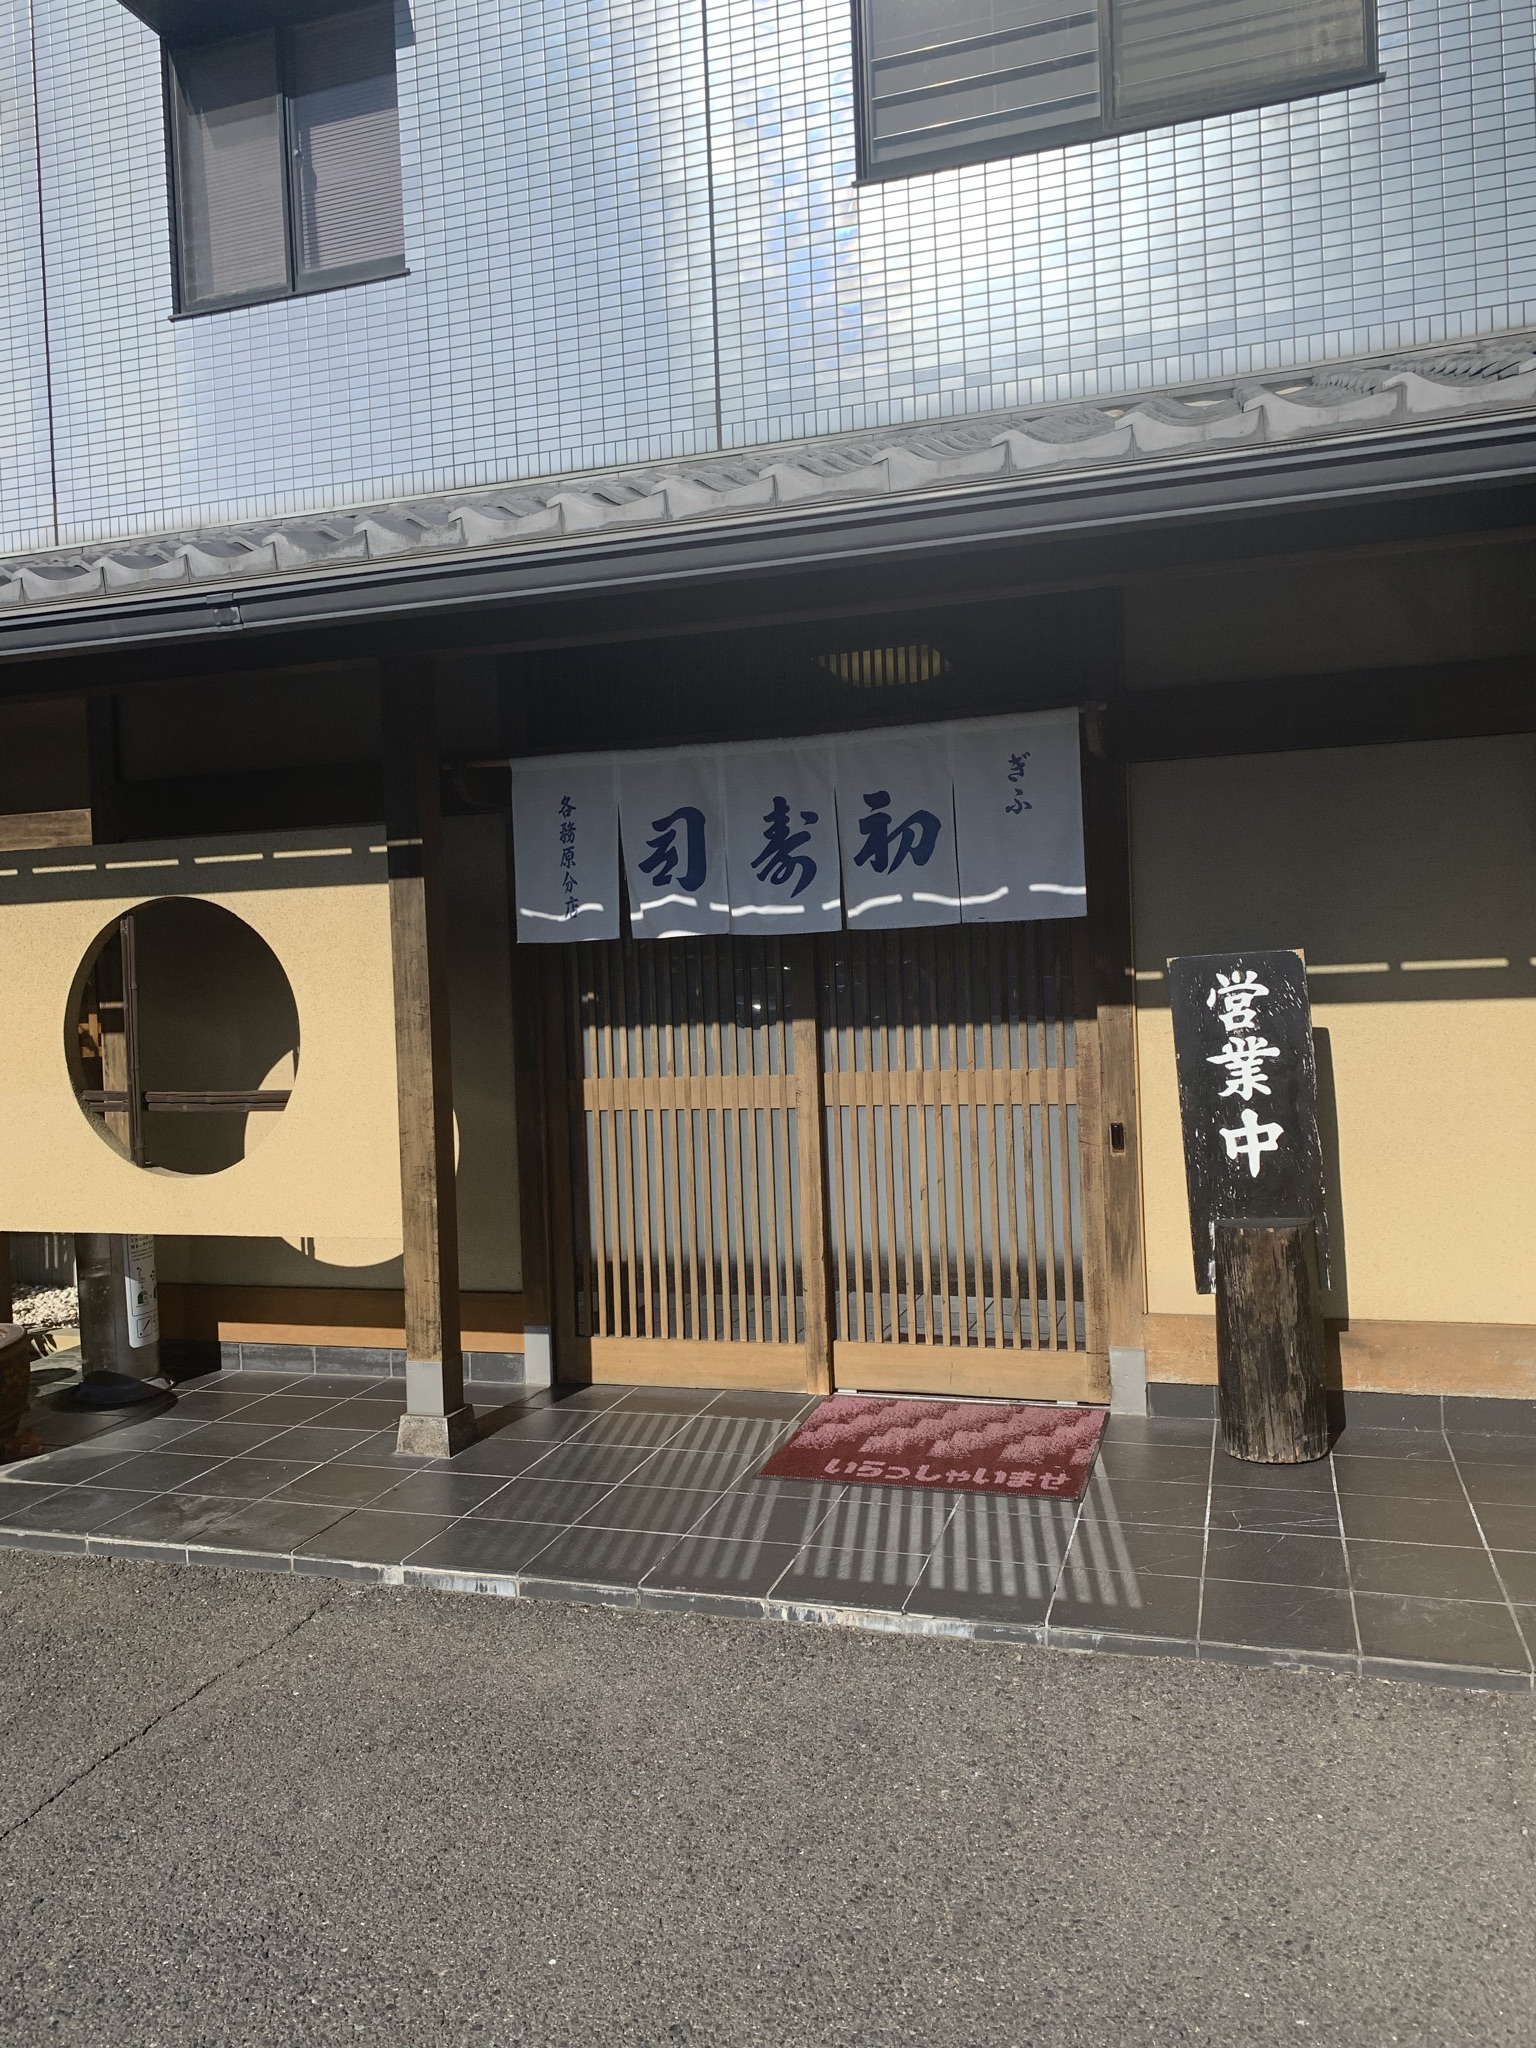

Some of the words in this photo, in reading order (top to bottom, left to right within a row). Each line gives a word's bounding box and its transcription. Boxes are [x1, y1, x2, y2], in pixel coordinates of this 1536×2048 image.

[1005, 751, 1032, 815] ぎふ
[559, 795, 579, 919] 各務原分店
[1205, 970, 1285, 1179] 営業中
[823, 1457, 1072, 1492] いらっしゃいませ
